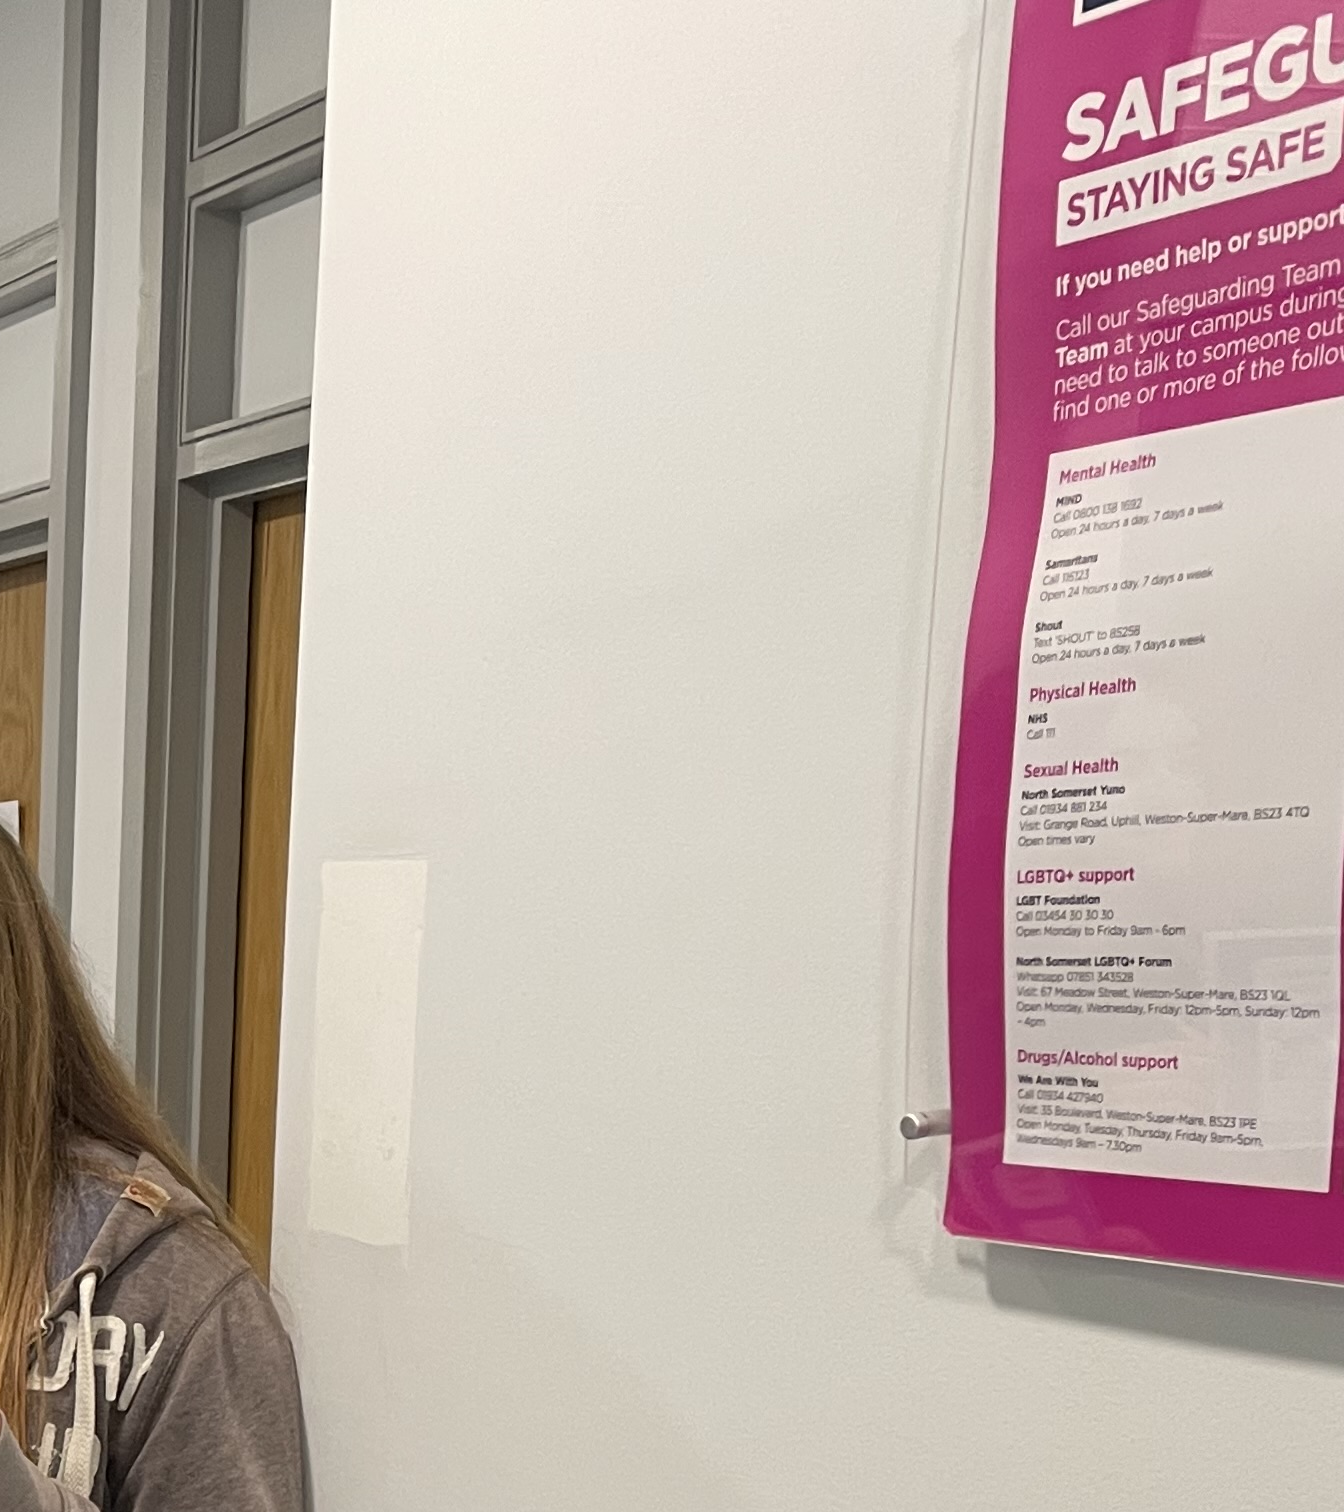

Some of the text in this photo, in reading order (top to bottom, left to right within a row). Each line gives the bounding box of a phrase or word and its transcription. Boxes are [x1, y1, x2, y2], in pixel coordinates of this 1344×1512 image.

[1066, 121, 1326, 227] STAYING SAFE
[1056, 273, 1070, 297] If
[1075, 267, 1112, 296] you
[1117, 247, 1169, 282] need
[1175, 238, 1222, 267] help
[1227, 231, 1252, 253] or
[1056, 258, 1341, 341] Call our Safeguarding Team
[1055, 341, 1109, 368] Team
[1113, 332, 1134, 355] at
[1139, 323, 1185, 354] your
[1190, 303, 1273, 338] campus
[1054, 364, 1103, 396] need
[1108, 363, 1128, 384] to
[1134, 351, 1170, 378] talk
[1176, 348, 1197, 369] to
[1202, 326, 1301, 363] someone
[1053, 343, 1344, 422] find one or more of the follo
[1059, 453, 1156, 485] Mental Health
[1055, 493, 1083, 507] MIND
[1034, 620, 1063, 633] Shout
[1029, 677, 1136, 704] Physical Health
[1027, 712, 1048, 724] NHS
[1023, 757, 1119, 779] Sexual Health
[1021, 785, 1126, 800] North Somerset Yuno
[1017, 867, 1135, 885] LGBTQ+ support
[1016, 894, 1101, 906] LGBT Foundation
[1016, 956, 1172, 967] North Somerset LGBTQ+ Forum
[1017, 1049, 1179, 1071] Drugs/Alcohol support
[1017, 1074, 1099, 1088] We Are With You
